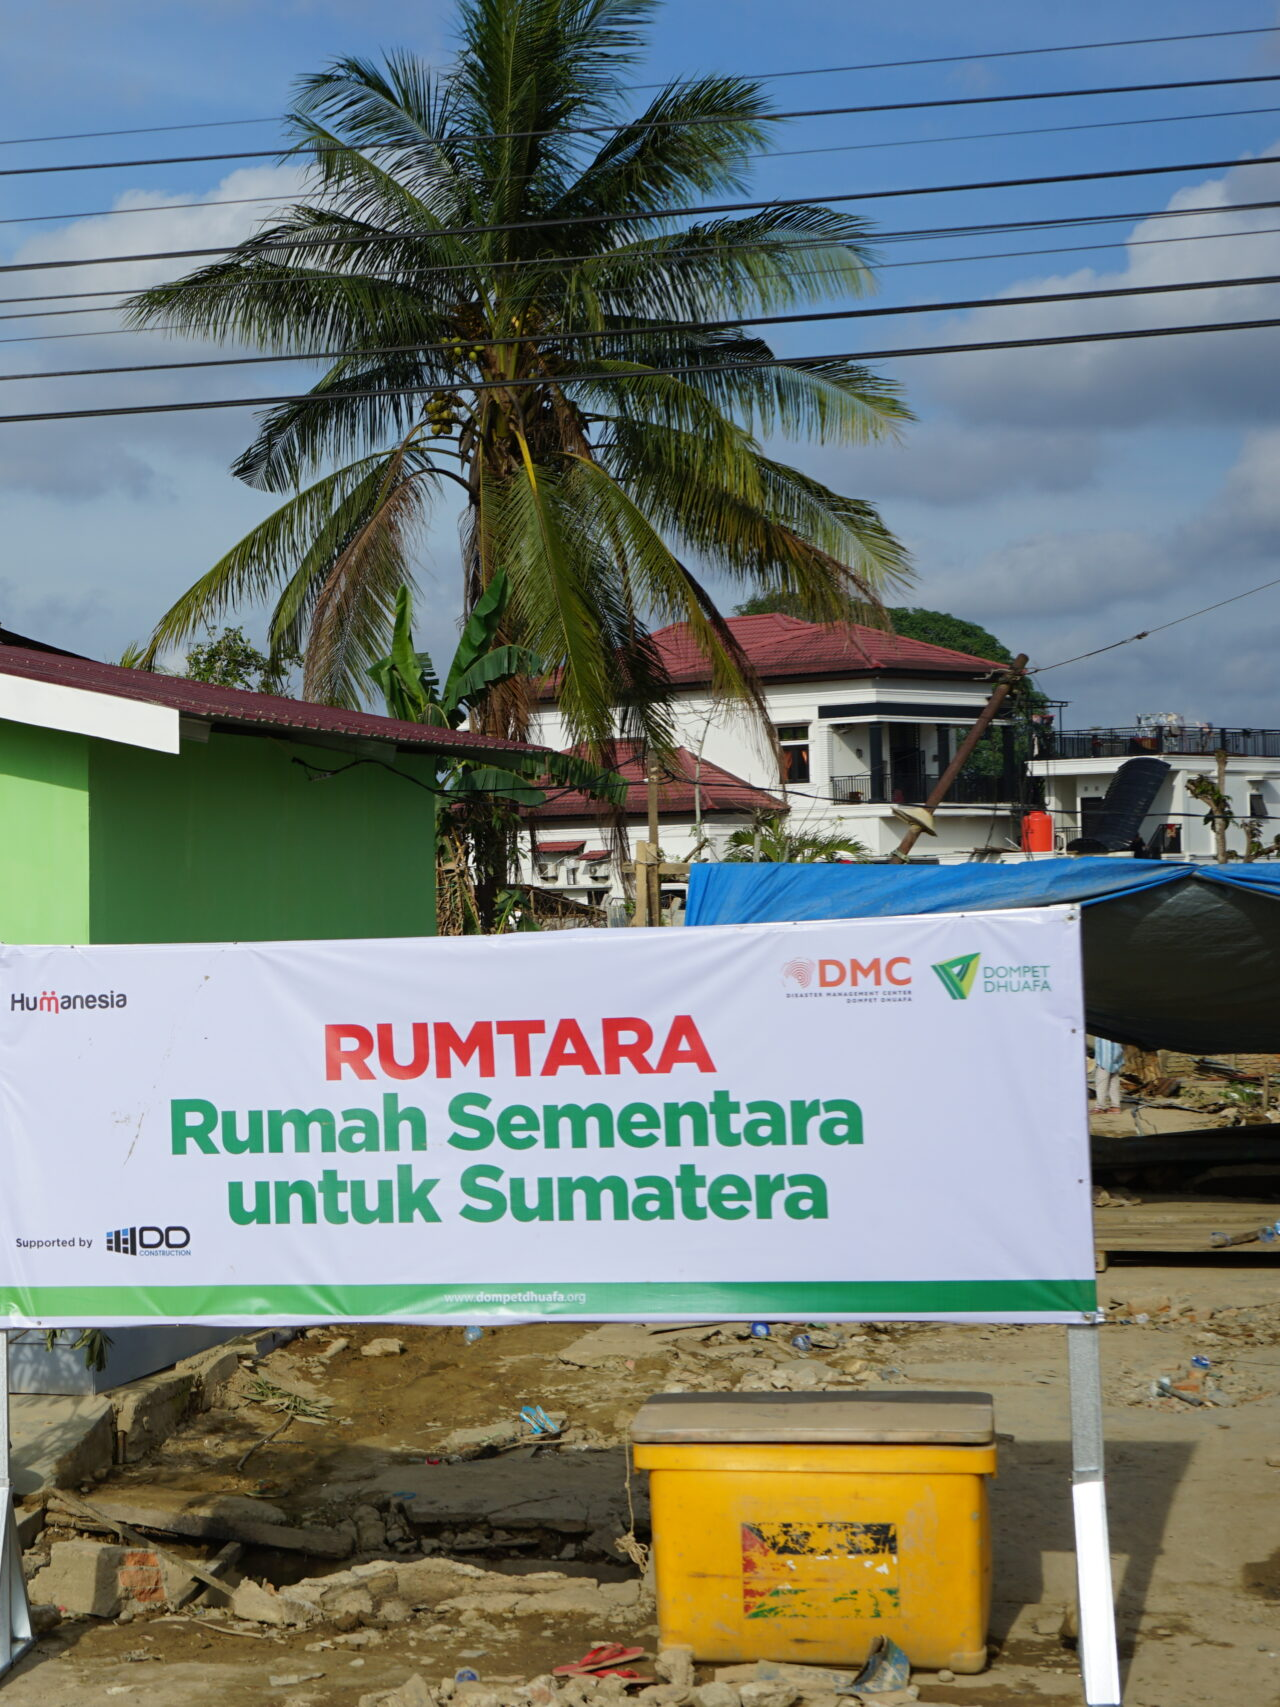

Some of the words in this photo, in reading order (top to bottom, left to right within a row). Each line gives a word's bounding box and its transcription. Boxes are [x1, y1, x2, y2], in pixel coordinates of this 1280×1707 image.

[818, 957, 912, 987] DMC
[983, 965, 1051, 979] DOMPET
[984, 979, 1052, 993] DHUAFA
[10, 990, 127, 1014] Humanesia
[324, 1014, 717, 1081] RUMTARA
[170, 1092, 428, 1155] Rumah
[447, 1090, 865, 1151] Sementara
[227, 1164, 443, 1226] untuk
[459, 1164, 829, 1224] Sumatera
[15, 1237, 75, 1249] Supported
[78, 1237, 93, 1249] by
[138, 1249, 192, 1257] CONSTRUCTION
[443, 1290, 587, 1305] www.dompetdhuafa.org
